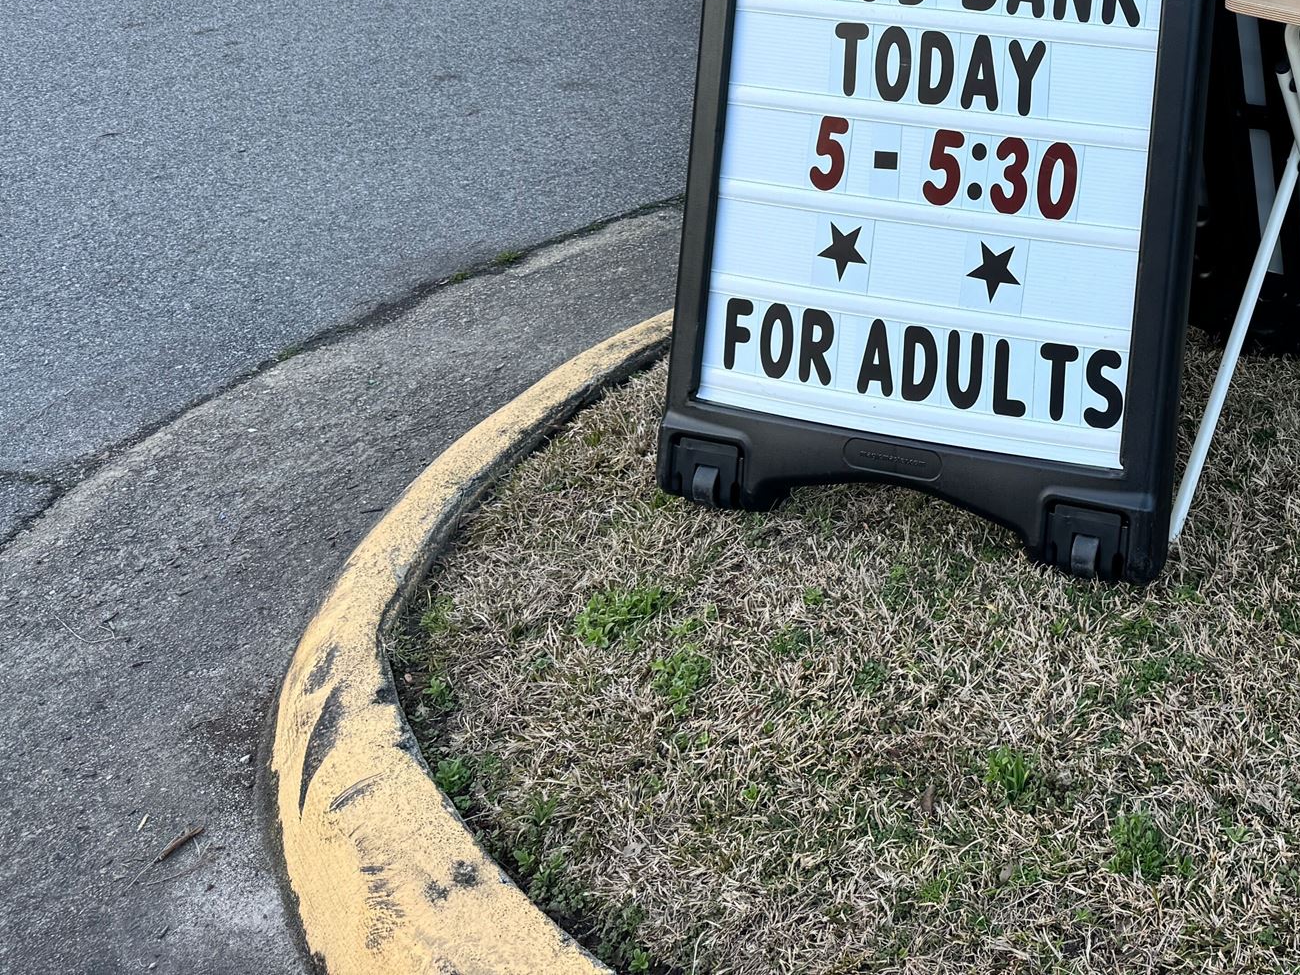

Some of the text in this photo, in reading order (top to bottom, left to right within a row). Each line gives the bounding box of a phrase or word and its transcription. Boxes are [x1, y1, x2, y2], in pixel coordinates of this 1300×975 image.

[834, 21, 1048, 117] TODAY
[808, 115, 850, 192] 5
[921, 128, 1079, 221] 5:30
[722, 297, 1124, 430] FOR ADULTS
